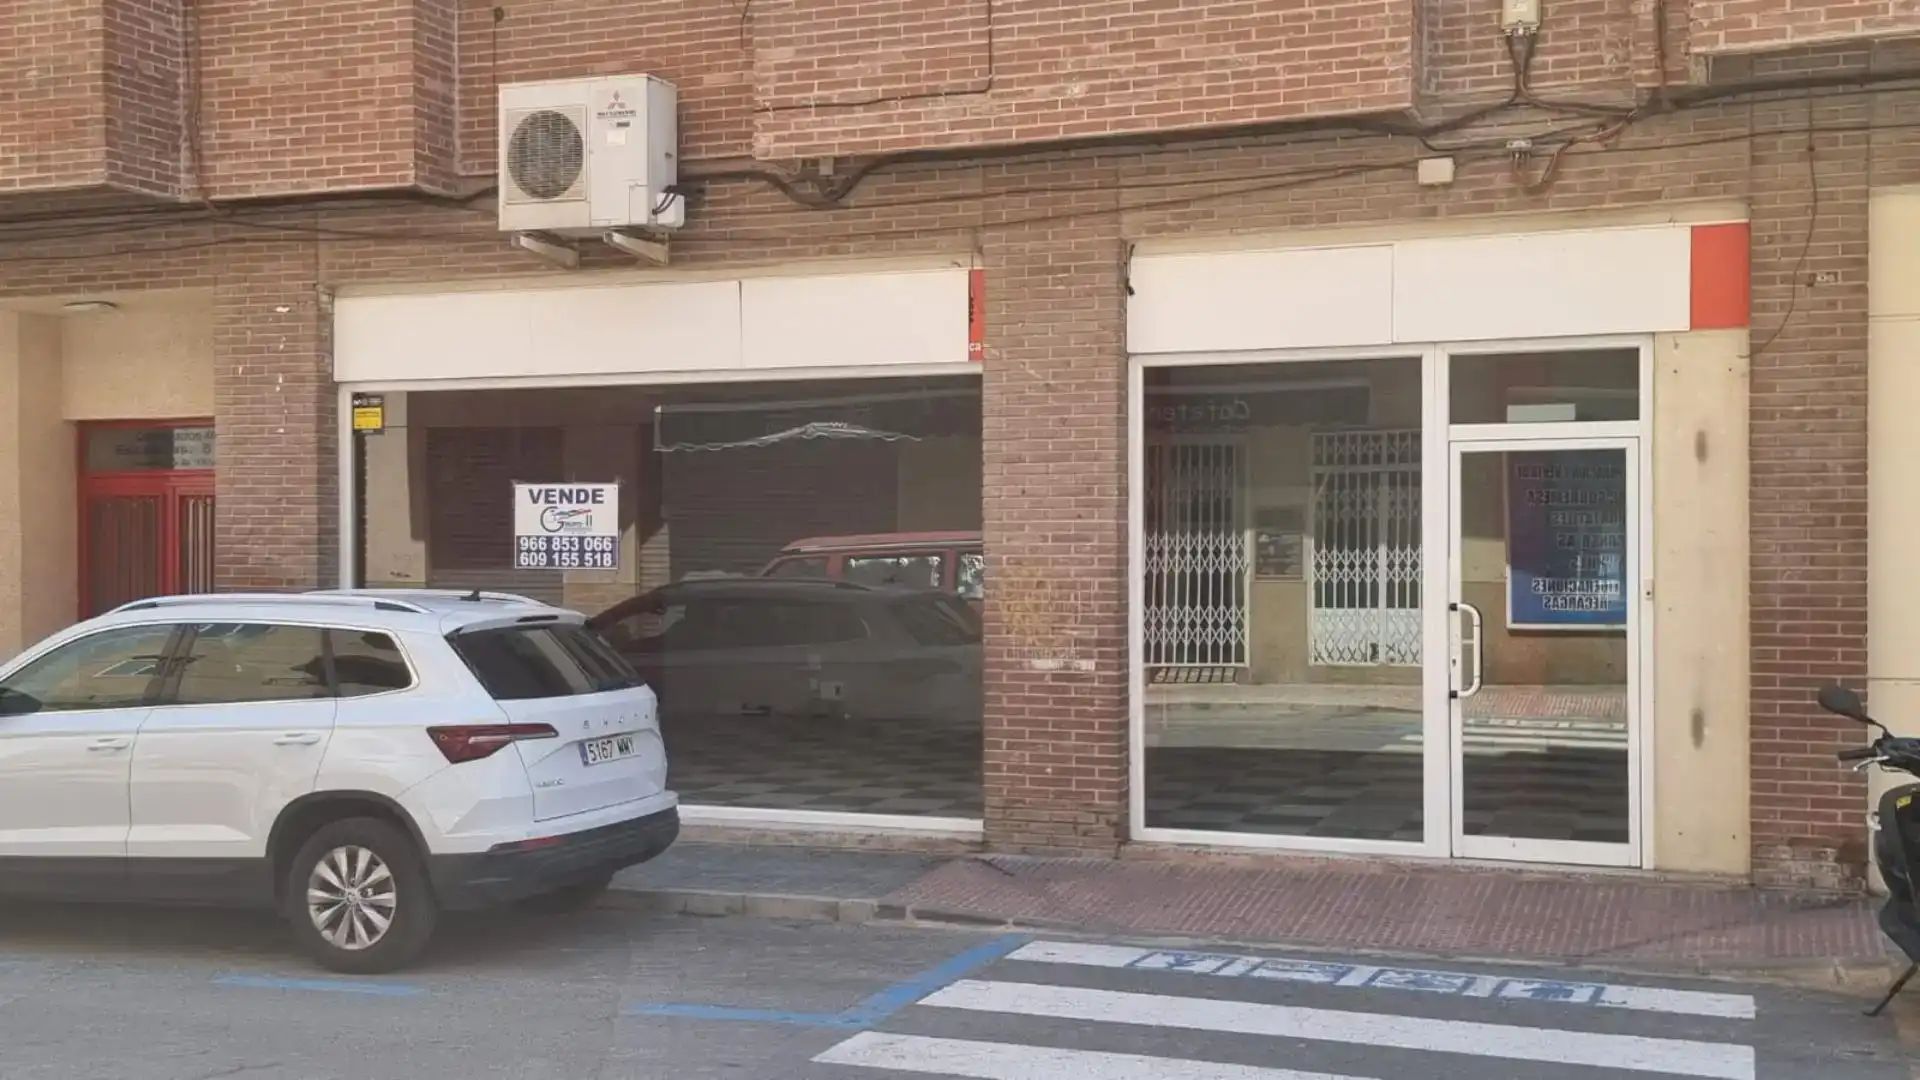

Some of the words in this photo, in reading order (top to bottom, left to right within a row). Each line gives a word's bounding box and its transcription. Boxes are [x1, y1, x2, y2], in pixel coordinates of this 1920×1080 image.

[528, 488, 605, 505] VENDE
[520, 537, 547, 551] 966
[552, 537, 580, 551] 853
[584, 537, 612, 551] 066
[520, 552, 547, 566] 609
[552, 552, 580, 566] 155
[584, 552, 612, 566] 518
[587, 741, 614, 762] 5167
